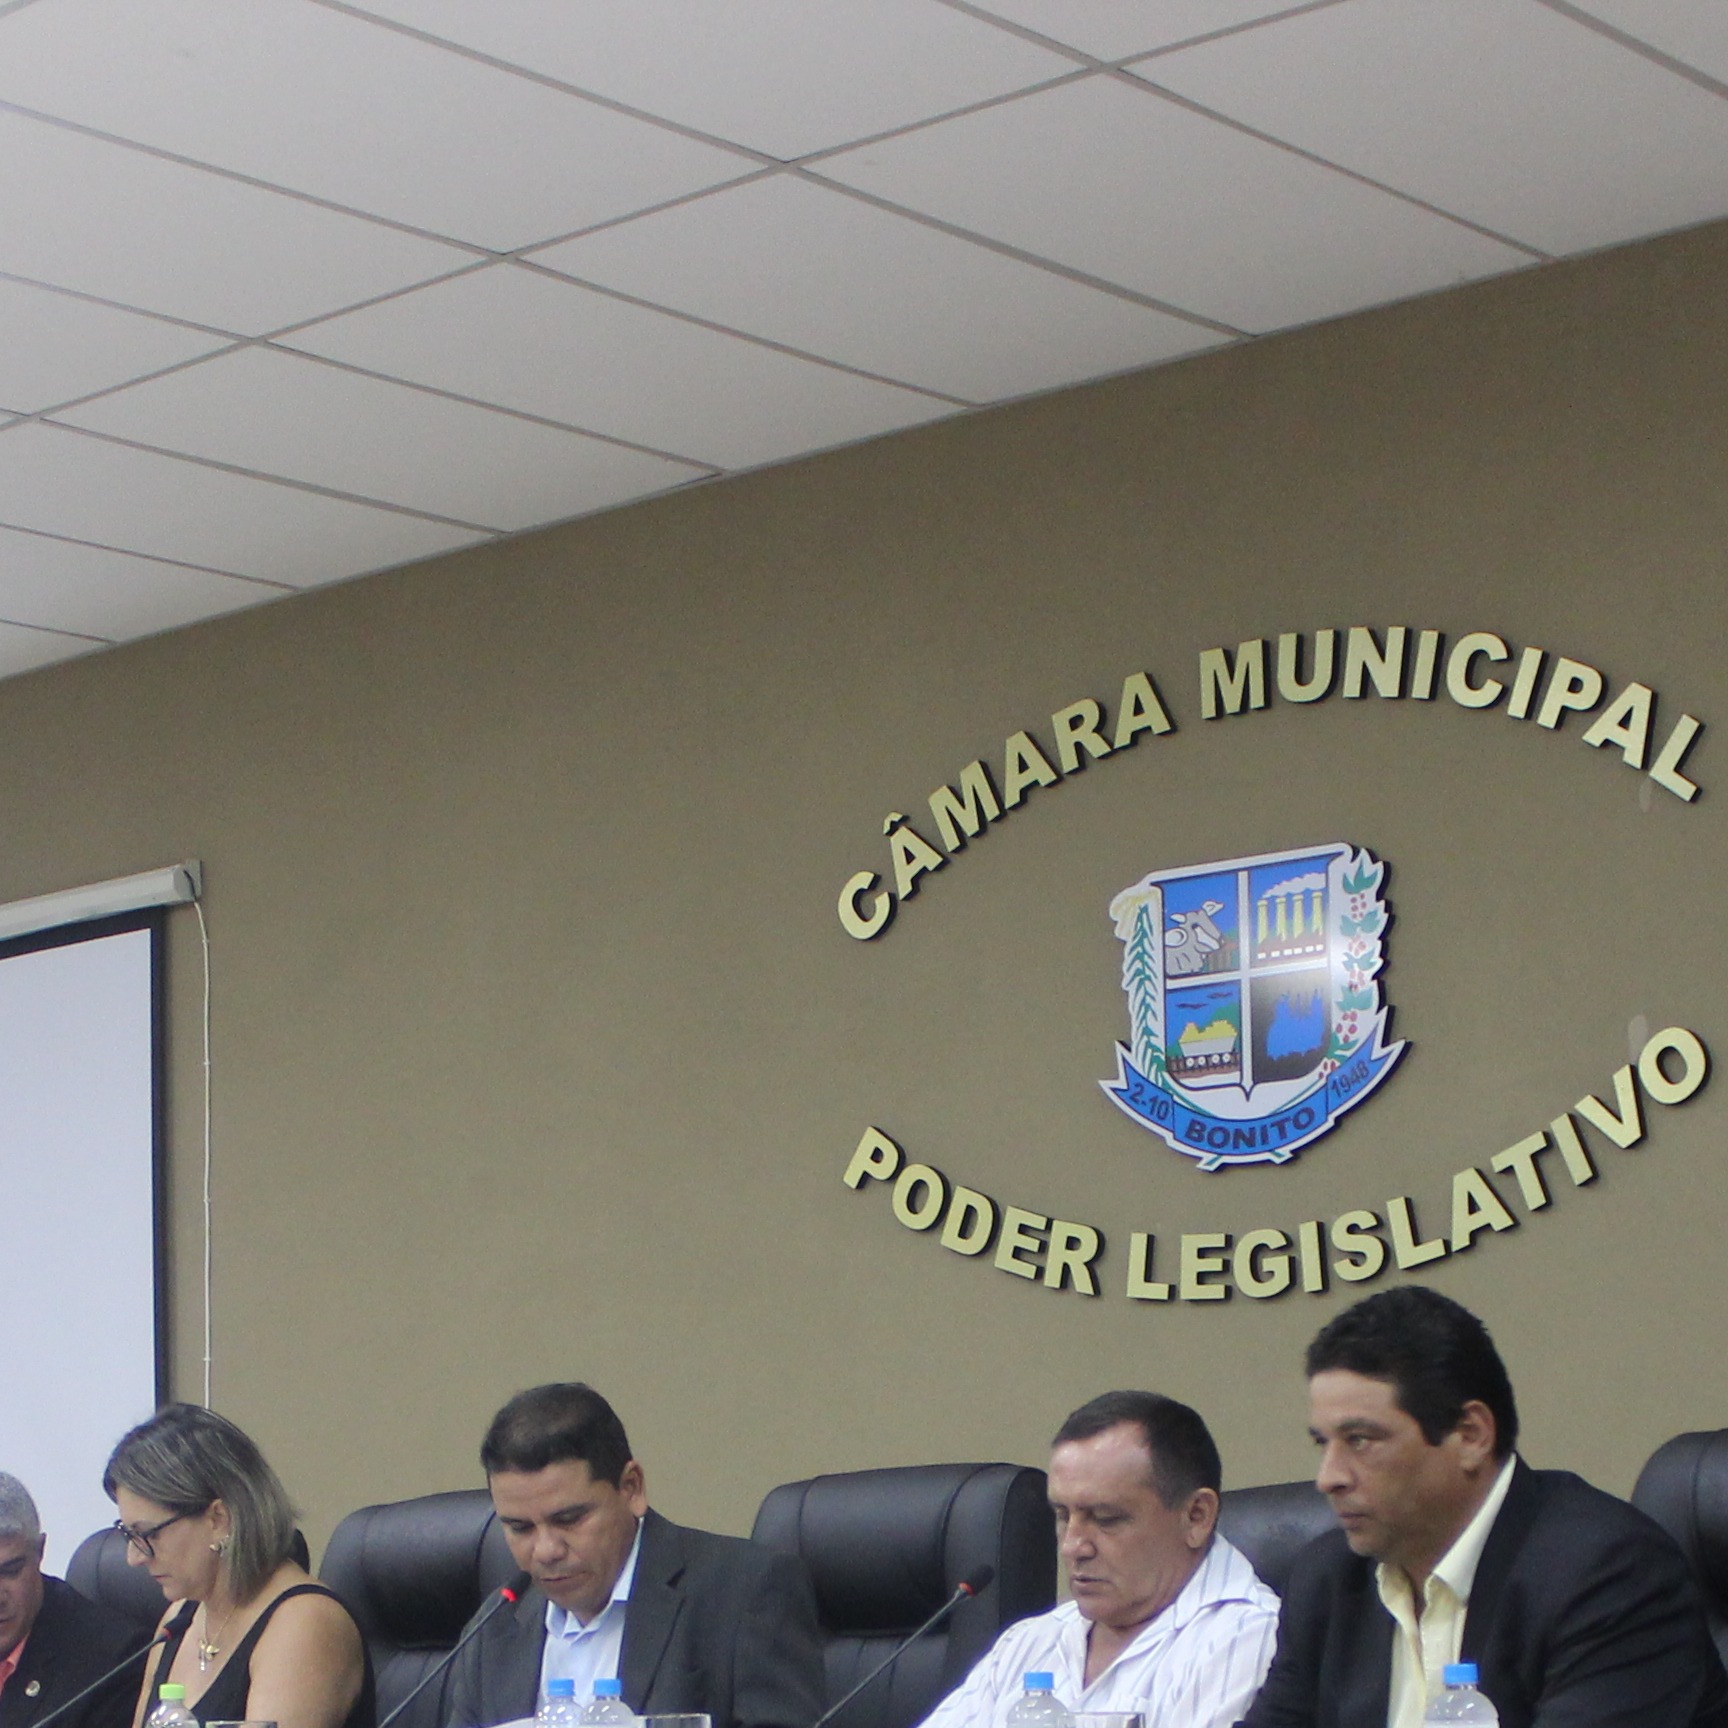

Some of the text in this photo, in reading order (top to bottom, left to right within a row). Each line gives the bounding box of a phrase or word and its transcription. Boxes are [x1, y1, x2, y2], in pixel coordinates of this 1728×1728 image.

[837, 626, 1700, 942] CÂMARA MUNICIPAL
[843, 1026, 1708, 1300] PODER LEGISLATIVO
[1184, 1106, 1315, 1149] BONITO
[1332, 1060, 1370, 1098] 1948
